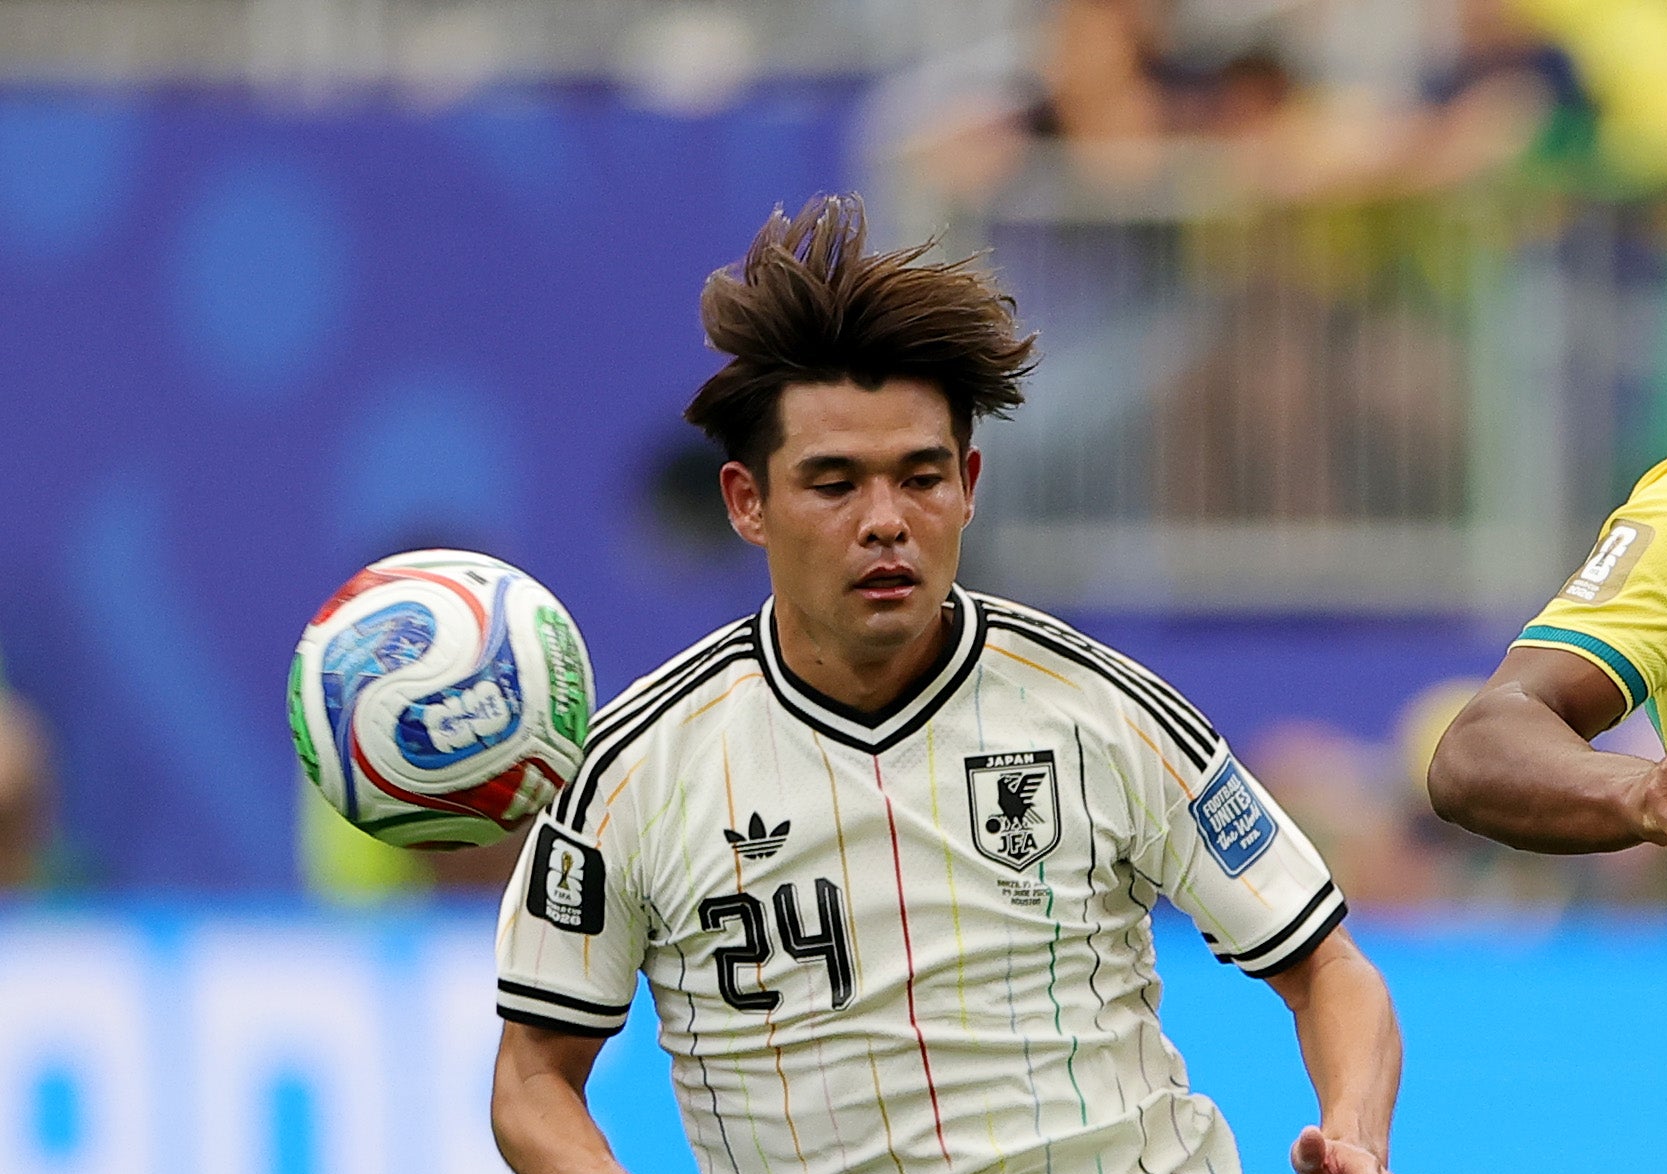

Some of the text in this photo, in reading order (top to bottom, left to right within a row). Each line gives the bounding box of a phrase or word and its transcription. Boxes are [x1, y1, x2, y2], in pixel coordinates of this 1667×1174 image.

[986, 753, 1034, 768] JAPAN
[1203, 774, 1241, 819] FOOTBALL
[1209, 785, 1252, 834] UNITES
[997, 832, 1038, 854] JFA
[698, 877, 857, 1014] 24
